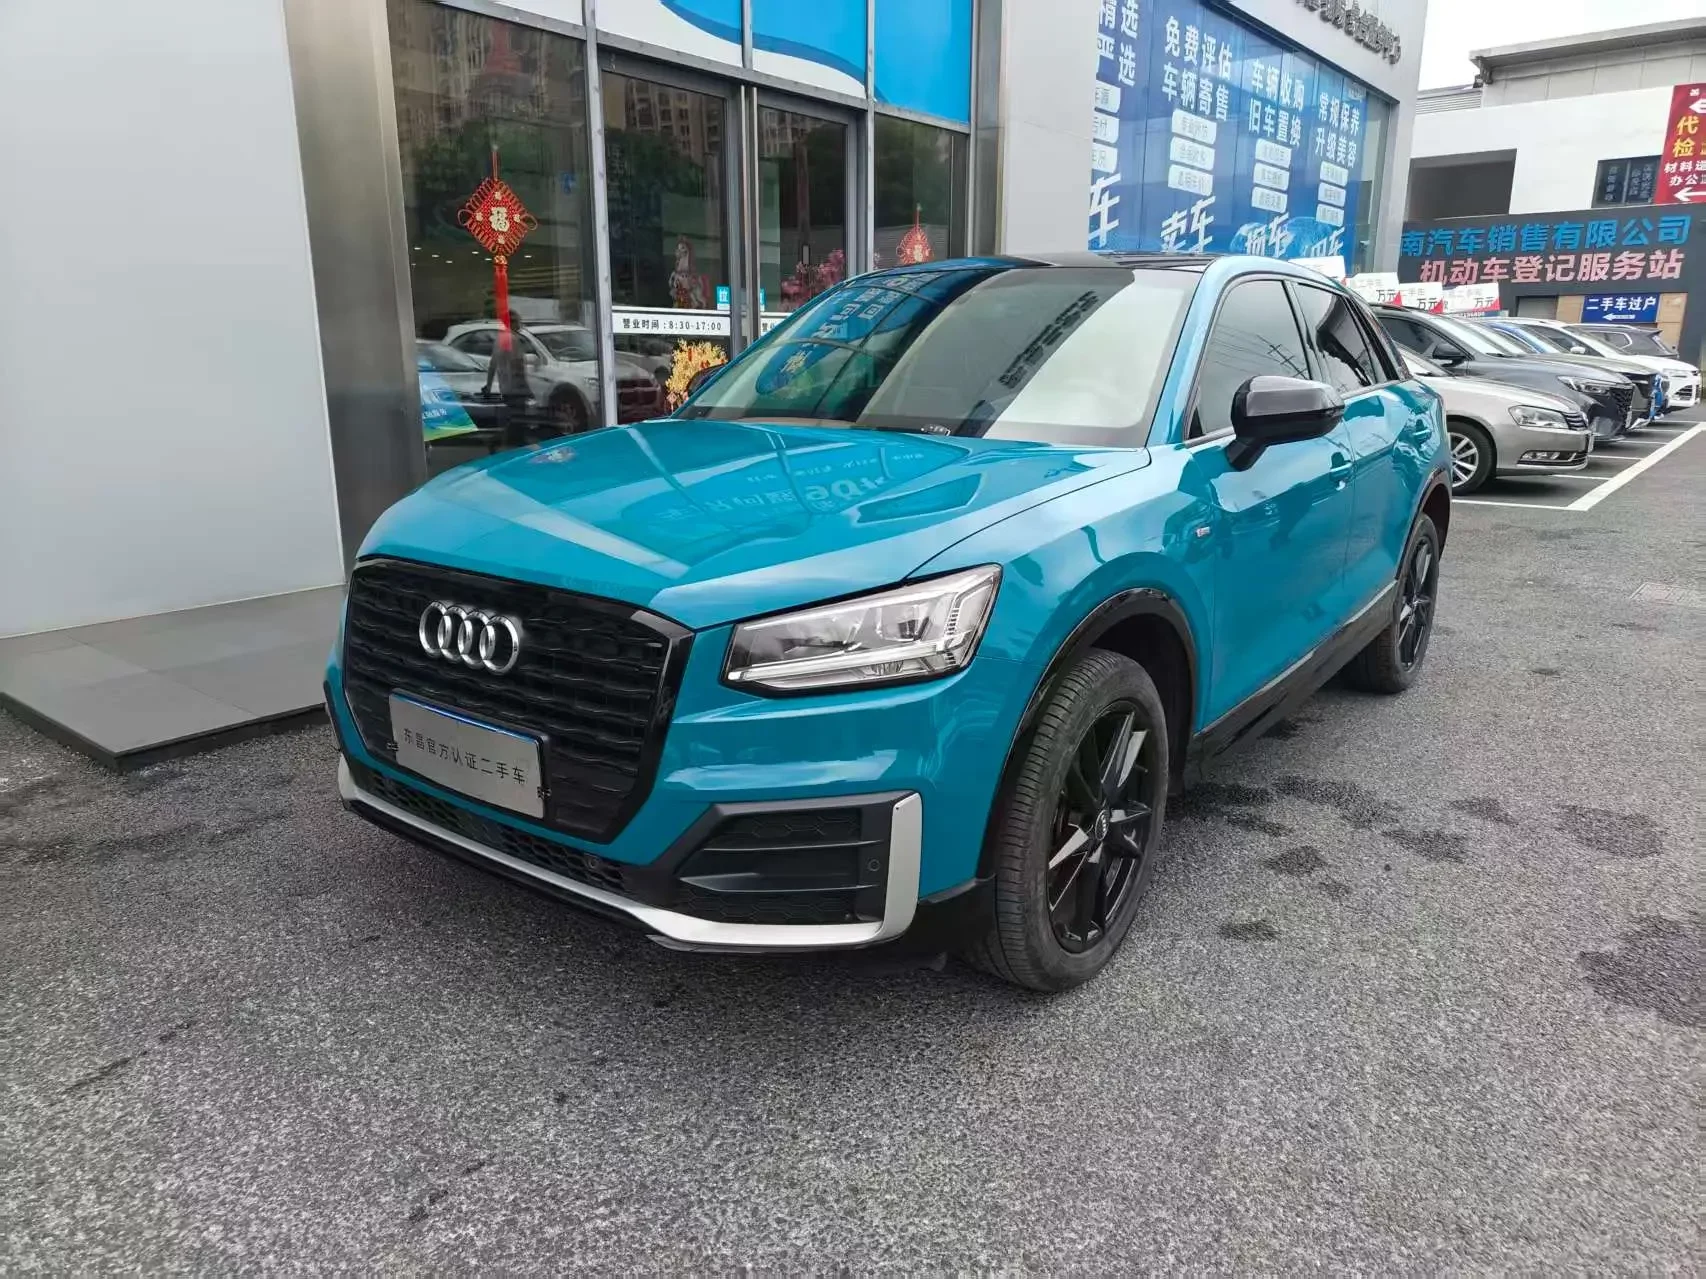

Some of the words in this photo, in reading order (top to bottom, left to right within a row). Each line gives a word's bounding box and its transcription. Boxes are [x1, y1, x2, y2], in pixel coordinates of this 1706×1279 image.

[1164, 15, 1233, 80] 免费评估
[1162, 61, 1229, 121] 车辆寄售
[1251, 58, 1304, 112] 车辆收购
[1249, 98, 1300, 147] 旧车置换
[1319, 91, 1359, 136] 常规保养
[1315, 127, 1356, 168] 升级美容
[1669, 174, 1706, 186] 办公
[1400, 214, 1692, 257] 南汽车销售有限公司
[1420, 248, 1686, 285] 机动车登记服务站
[1586, 296, 1656, 312] 二手车过户
